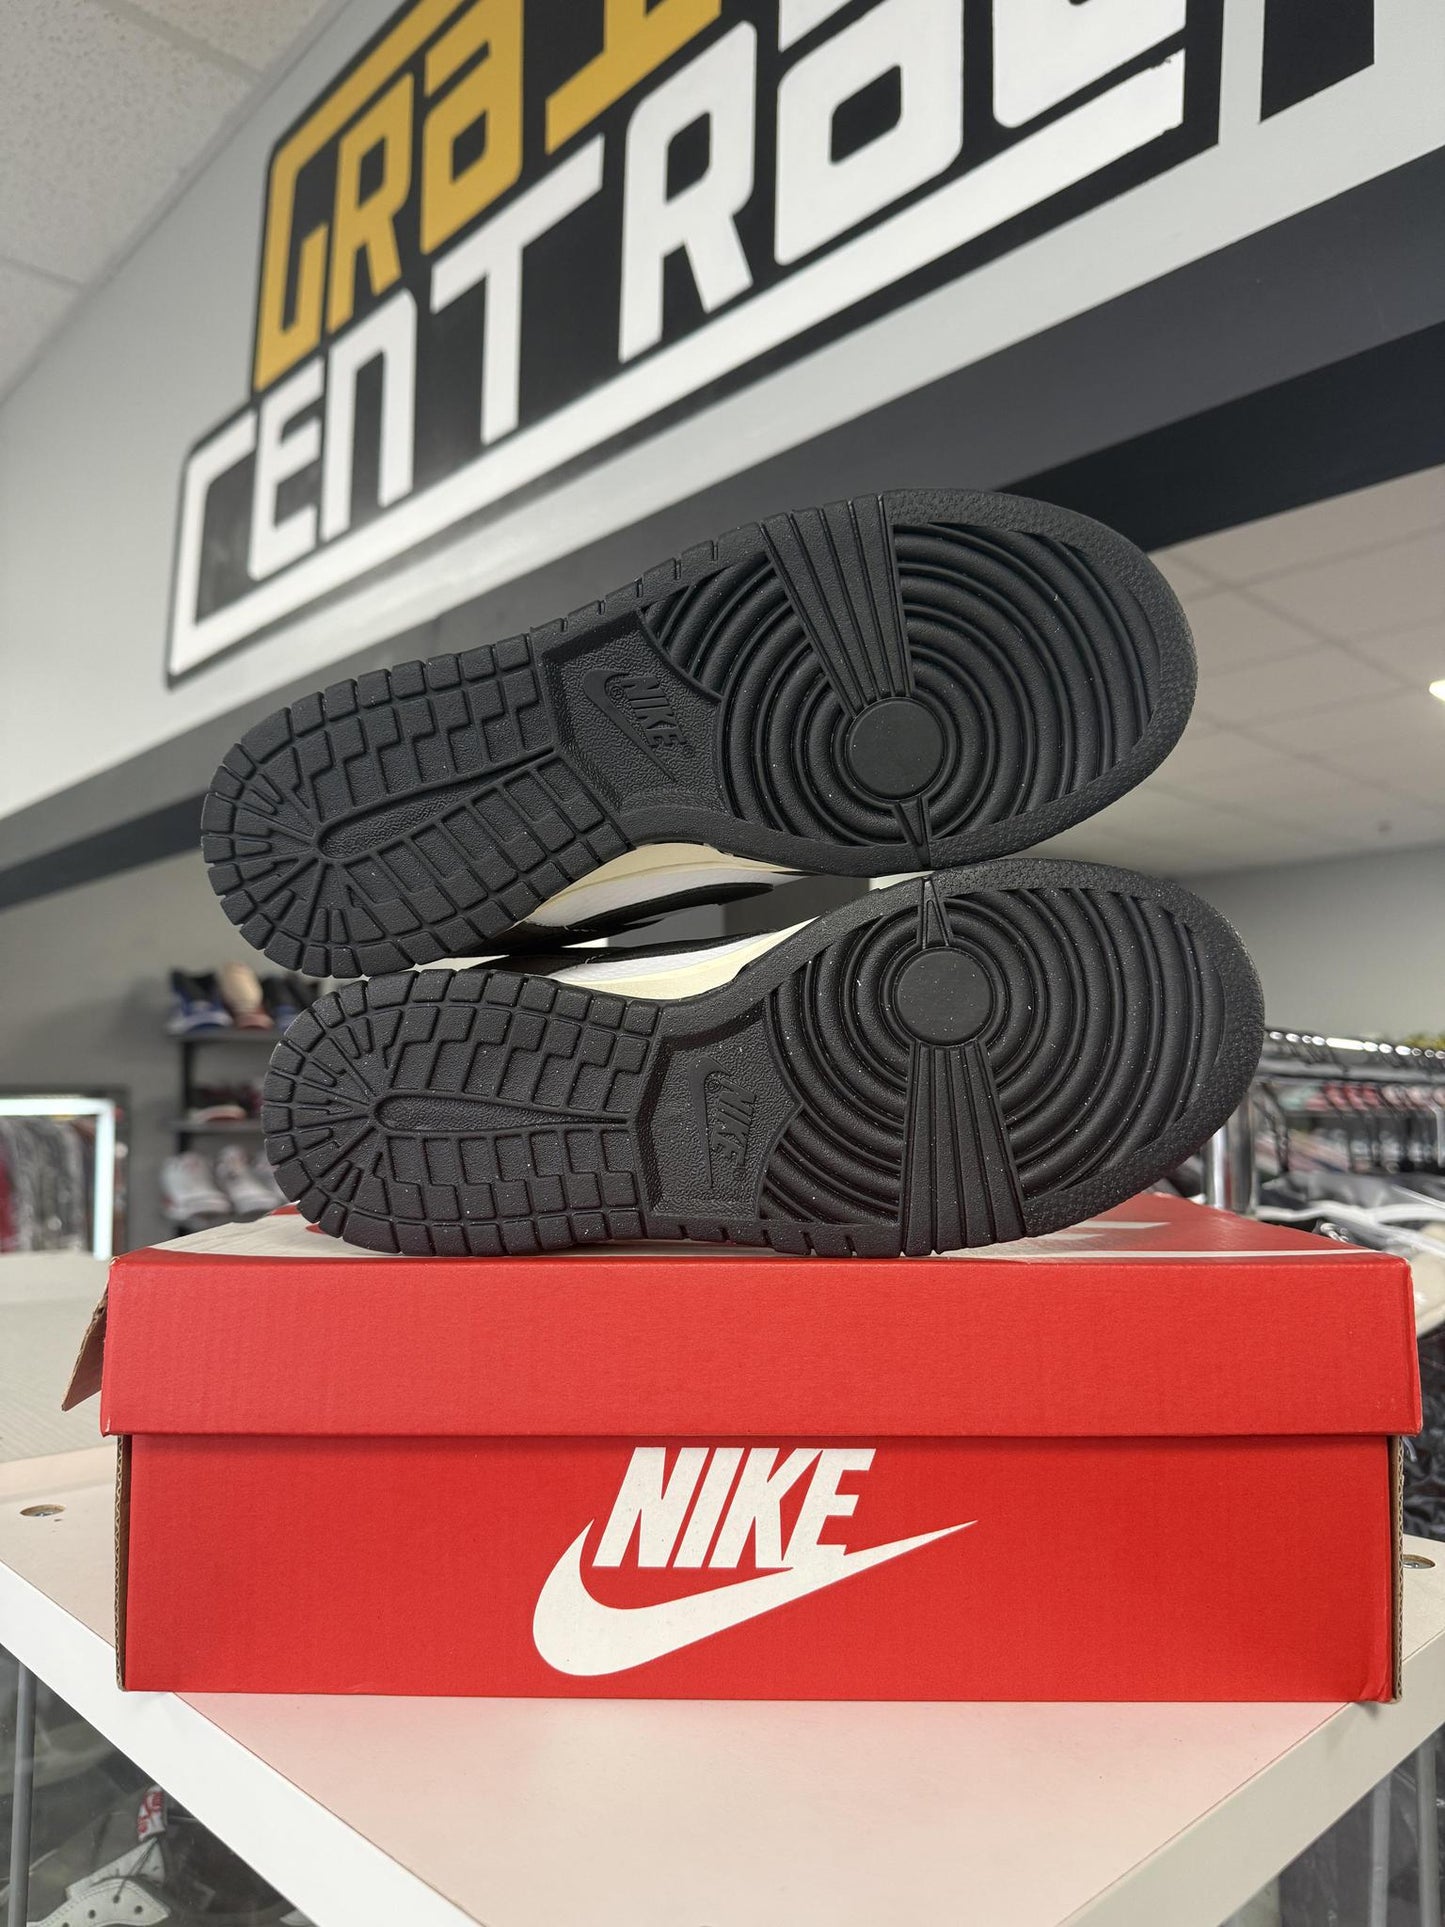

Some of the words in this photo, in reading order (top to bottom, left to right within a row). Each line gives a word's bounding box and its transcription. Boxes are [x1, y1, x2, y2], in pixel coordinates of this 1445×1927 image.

[620, 674, 688, 748] NIKE
[711, 1077, 757, 1166] NIKE
[592, 1446, 877, 1569] NIKE
